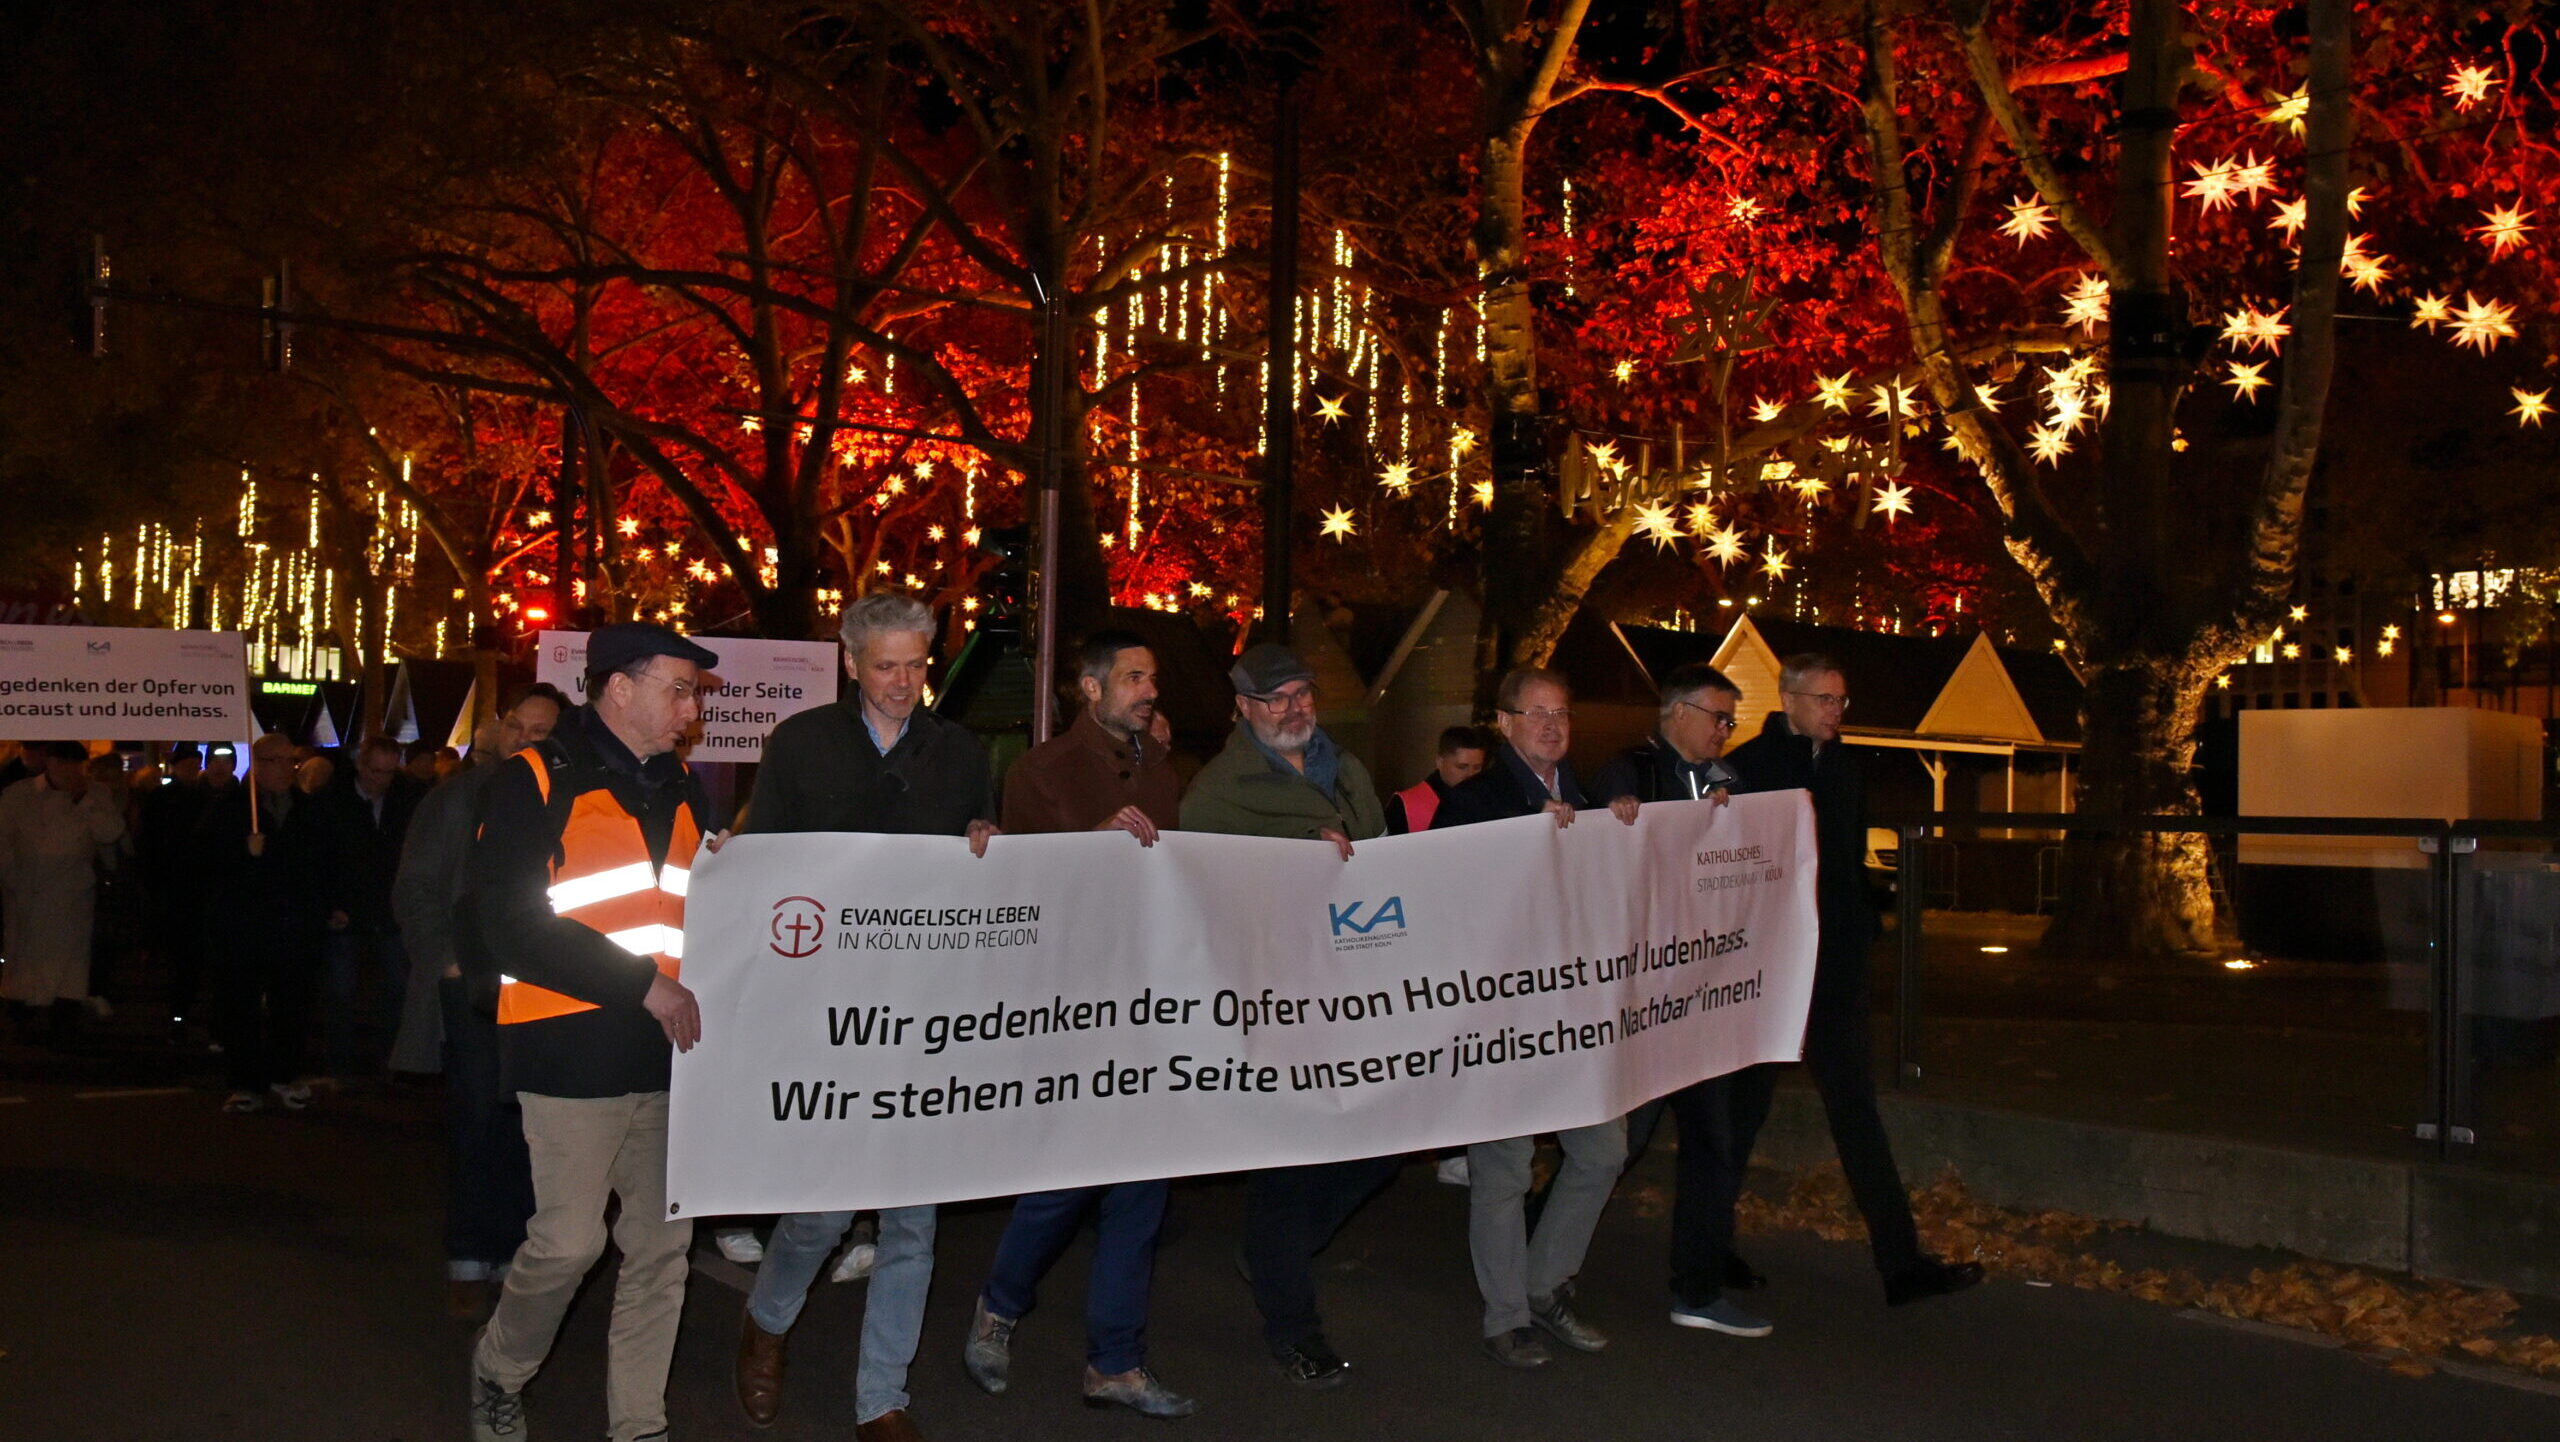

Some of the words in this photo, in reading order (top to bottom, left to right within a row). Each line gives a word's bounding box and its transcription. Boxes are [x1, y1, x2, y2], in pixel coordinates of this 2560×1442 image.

[0, 677, 99, 695] gedenken
[105, 678, 138, 693] der
[143, 679, 197, 698] Opfer
[201, 683, 235, 695] von
[719, 681, 751, 698] der
[755, 682, 803, 699] Seite
[0, 701, 74, 716] ocaust
[80, 701, 116, 716] und
[121, 702, 228, 718] Judenhass.
[702, 706, 777, 723] dischen
[1696, 845, 1761, 866] KATHOLISCHES
[840, 908, 982, 927] EVANGELISCH
[986, 905, 1040, 925] LEBEN
[1328, 896, 1406, 936] KA
[838, 932, 860, 950] IN
[866, 928, 922, 950] KÖLN
[927, 931, 970, 950] UND
[975, 928, 1039, 949] REGION
[827, 1004, 915, 1046] Wir
[923, 995, 1117, 1055] gedenken
[1129, 988, 1201, 1026] der
[1213, 988, 1310, 1036] Opfer
[1317, 991, 1393, 1023] von
[1402, 956, 1589, 1013] Holocaust
[1595, 942, 1639, 984] und
[1641, 927, 1749, 974] Judenhass.
[771, 1080, 860, 1121] Wir
[871, 1075, 1023, 1120] stehen
[1034, 1070, 1079, 1105] an
[1091, 1059, 1158, 1098] der
[1167, 1054, 1279, 1093] Seite
[1289, 1047, 1444, 1092] unserer
[1450, 1019, 1615, 1078] jüdischen
